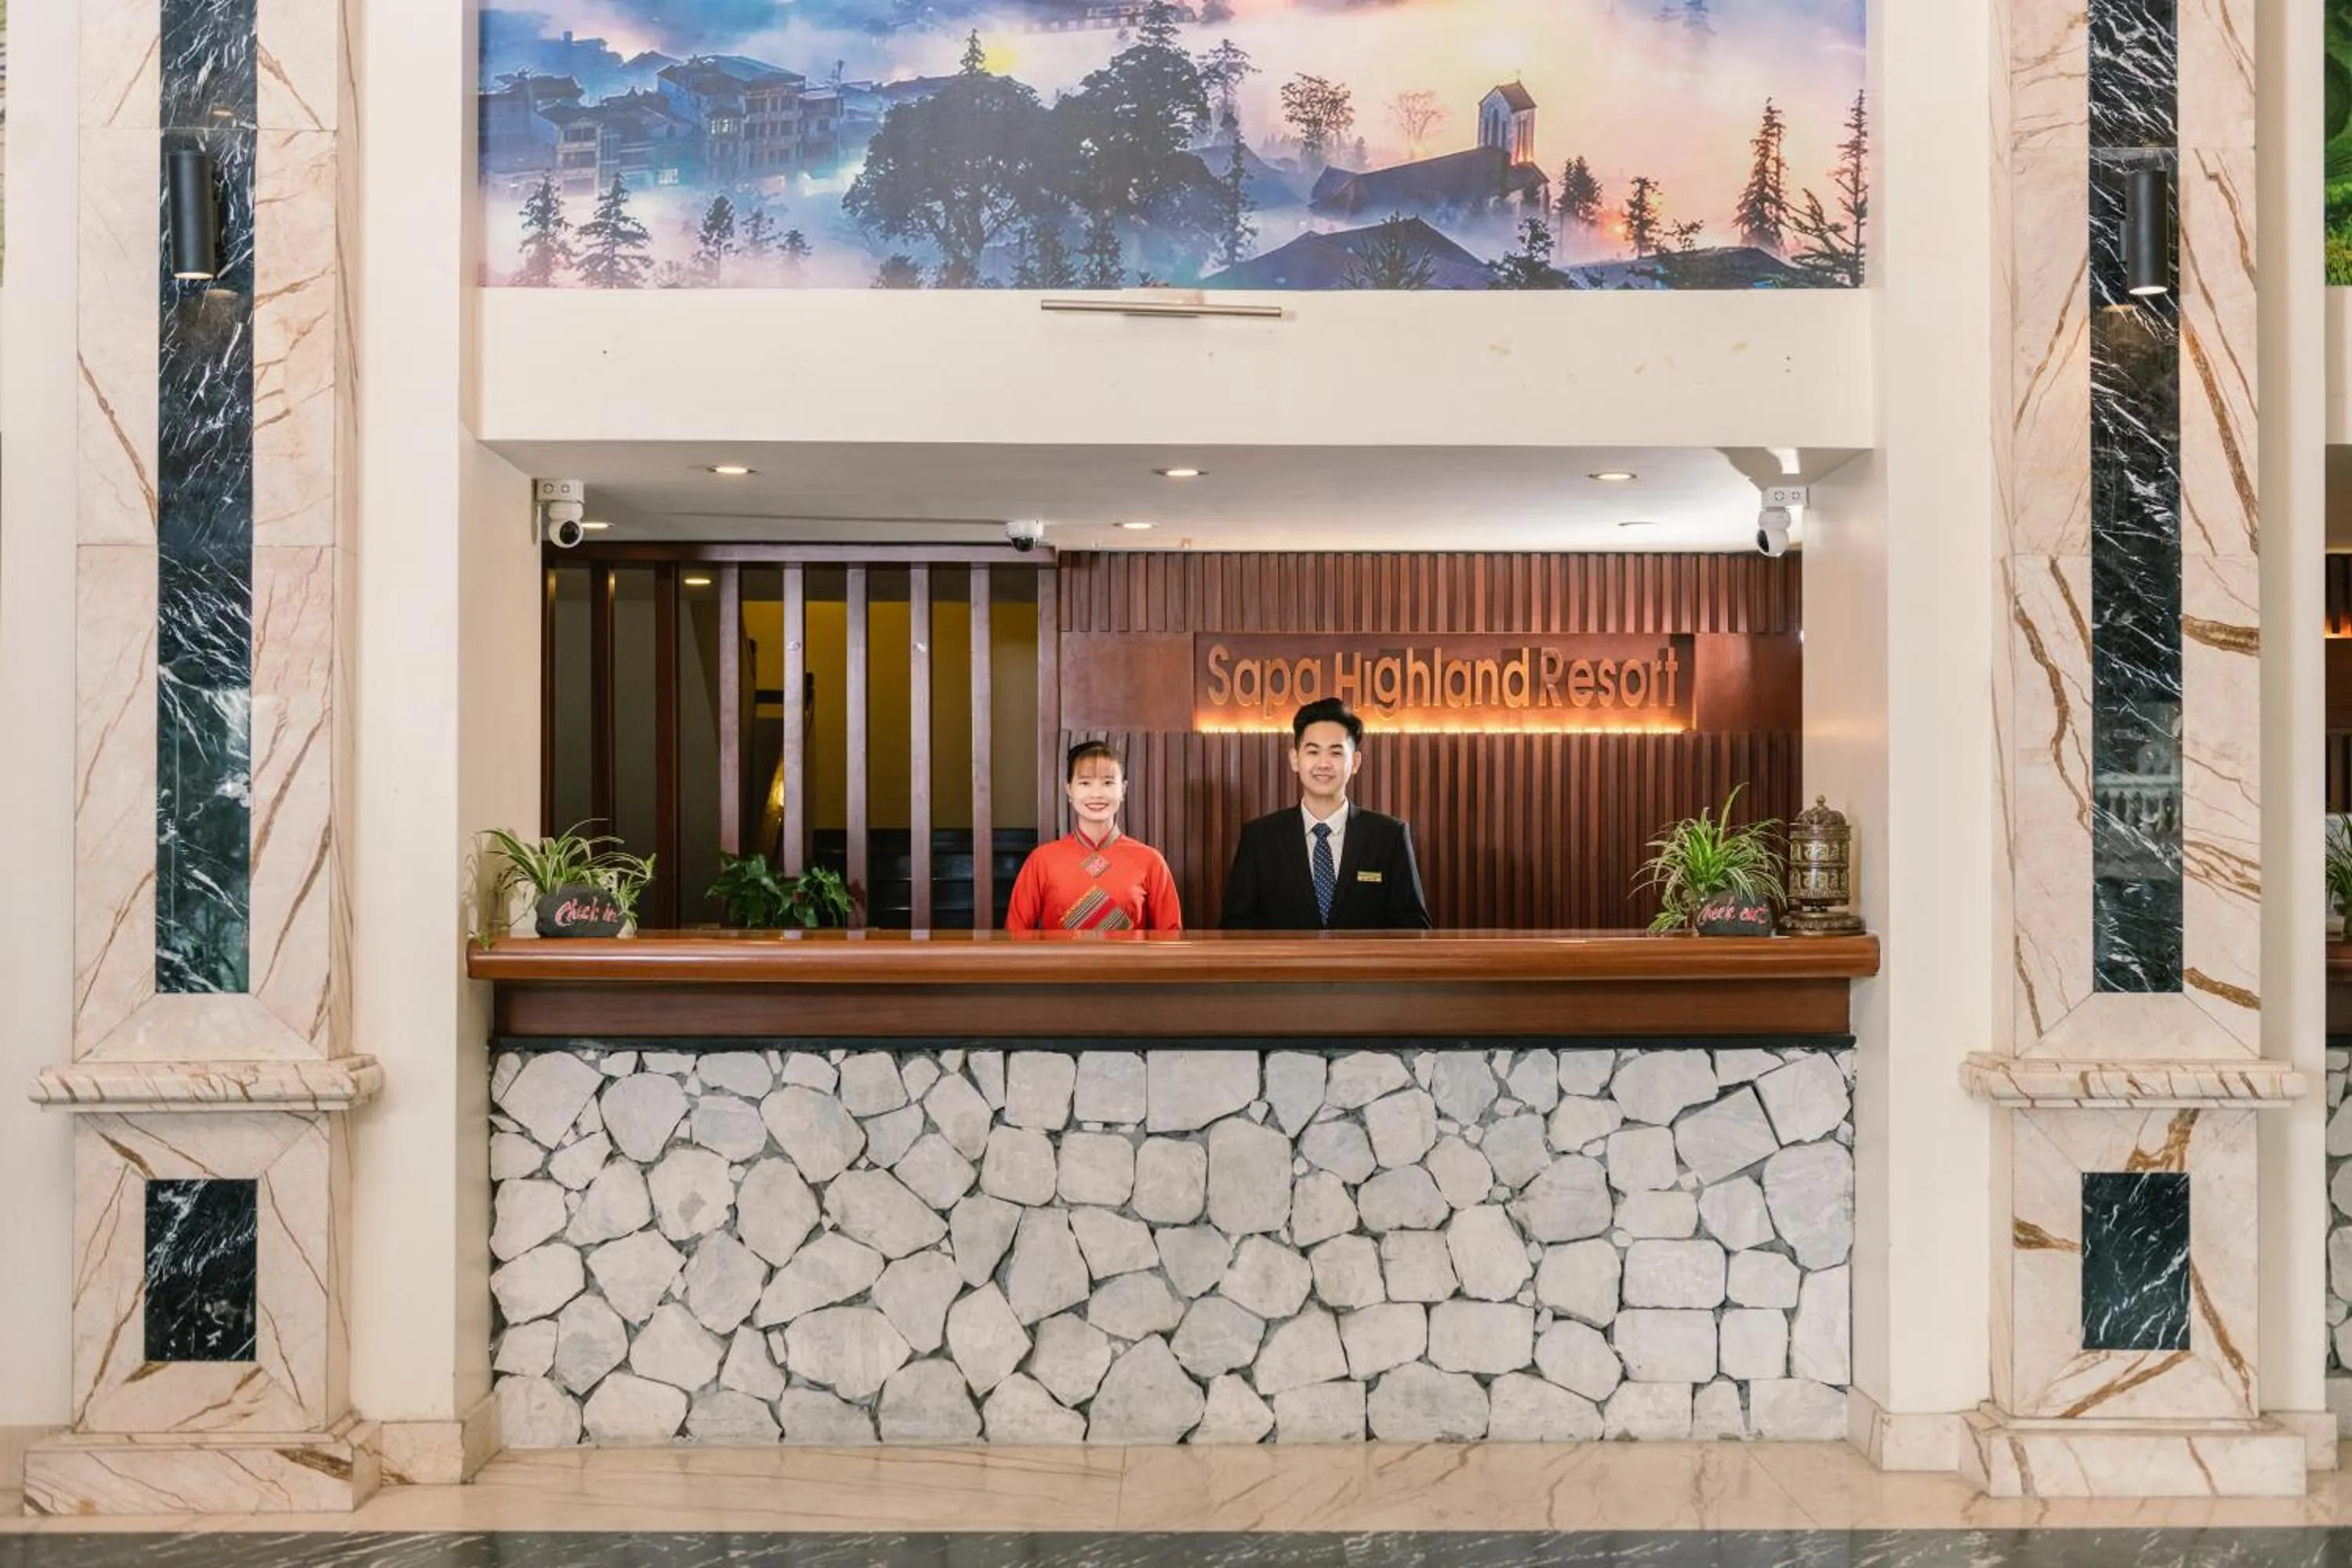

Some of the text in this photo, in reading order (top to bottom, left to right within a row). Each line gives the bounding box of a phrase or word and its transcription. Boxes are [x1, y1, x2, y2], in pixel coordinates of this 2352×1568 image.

[1207, 644, 1679, 720] Sapa Highland Resort
